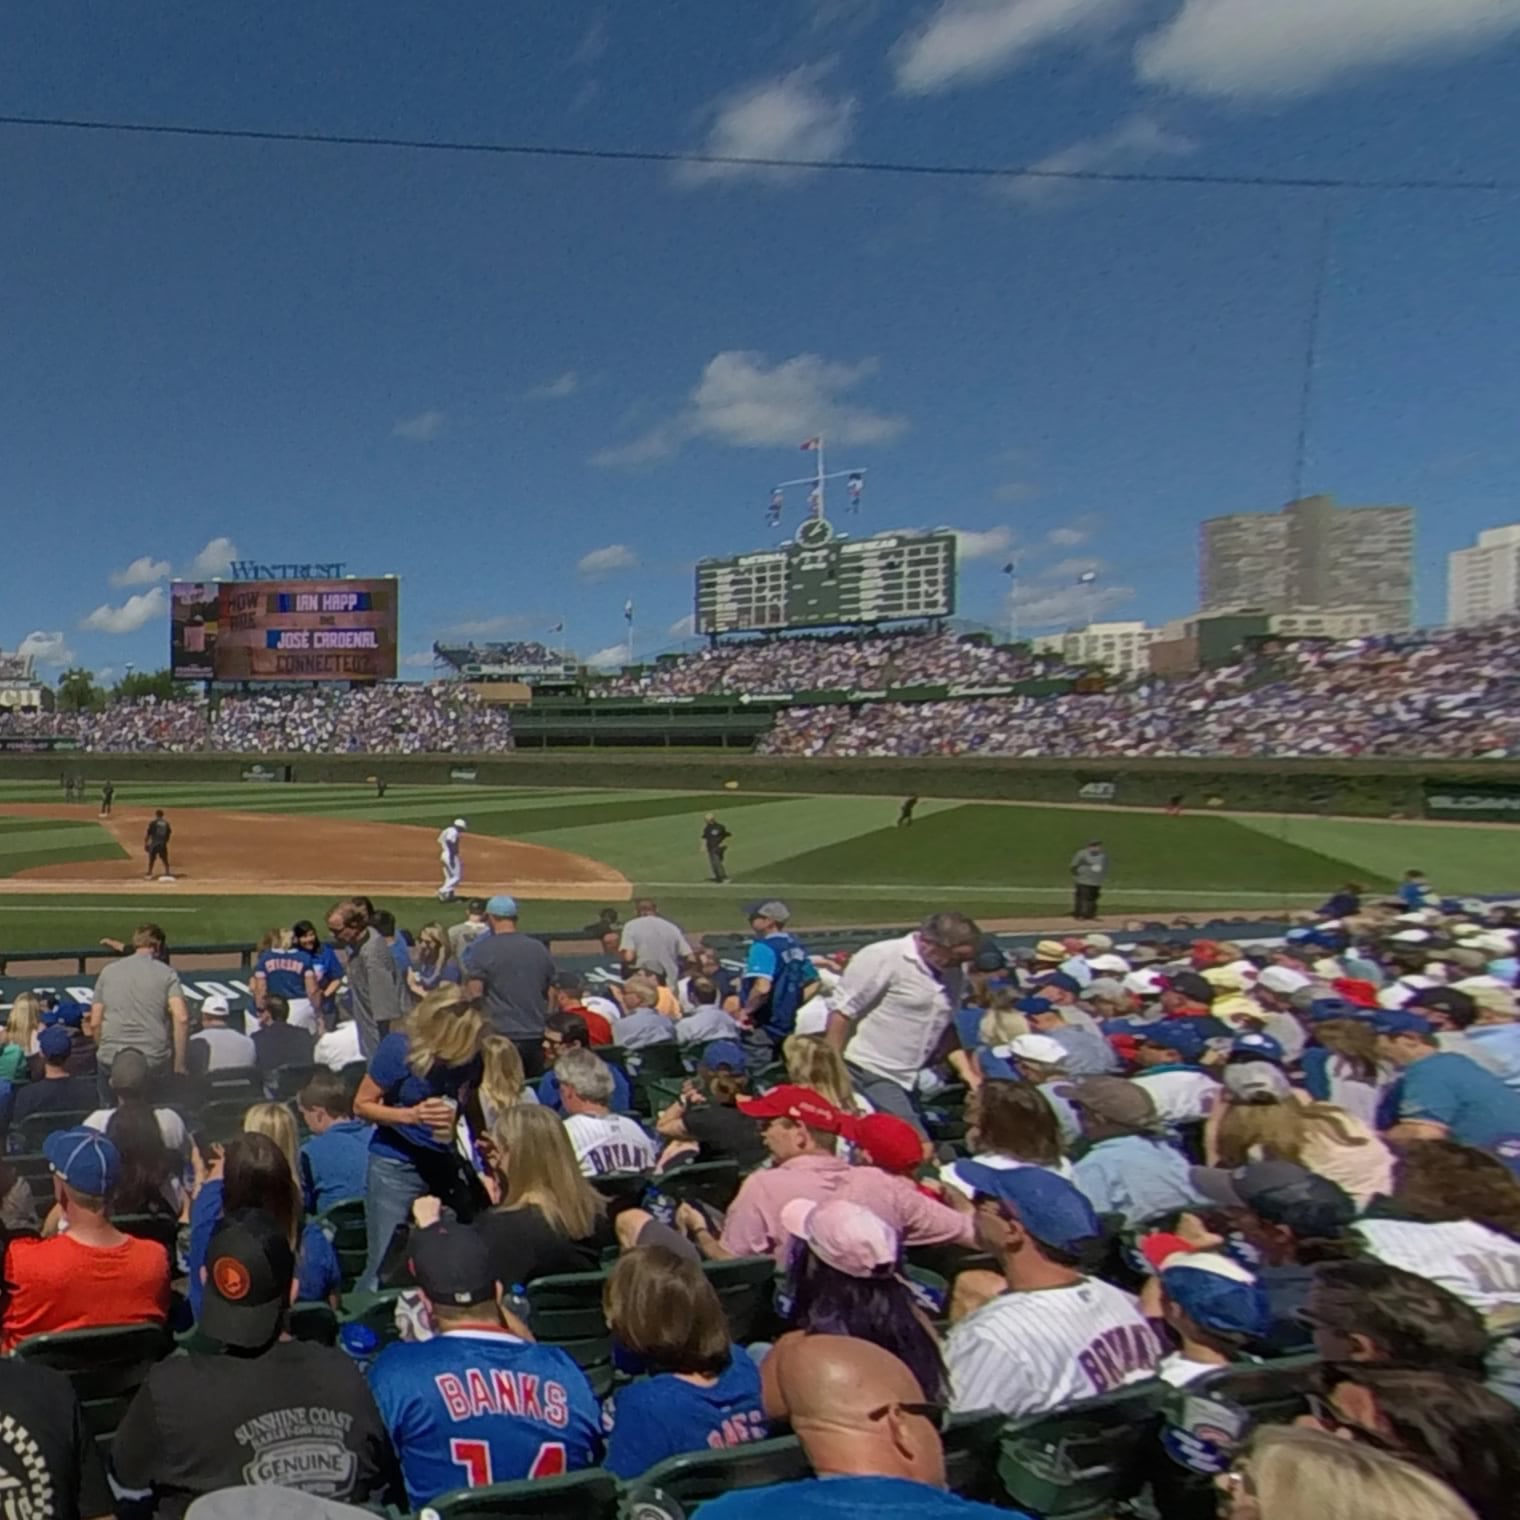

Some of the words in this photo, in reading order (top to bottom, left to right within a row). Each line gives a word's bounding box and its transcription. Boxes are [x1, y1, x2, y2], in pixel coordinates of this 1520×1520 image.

[296, 594, 318, 611] IAN
[322, 594, 359, 611] HAPP
[313, 632, 379, 648] CARDENAL
[435, 1368, 569, 1428] BANKS
[234, 1408, 307, 1445] SUNSHINE
[309, 1407, 355, 1432] COAST
[258, 1452, 344, 1481] GENUINE
